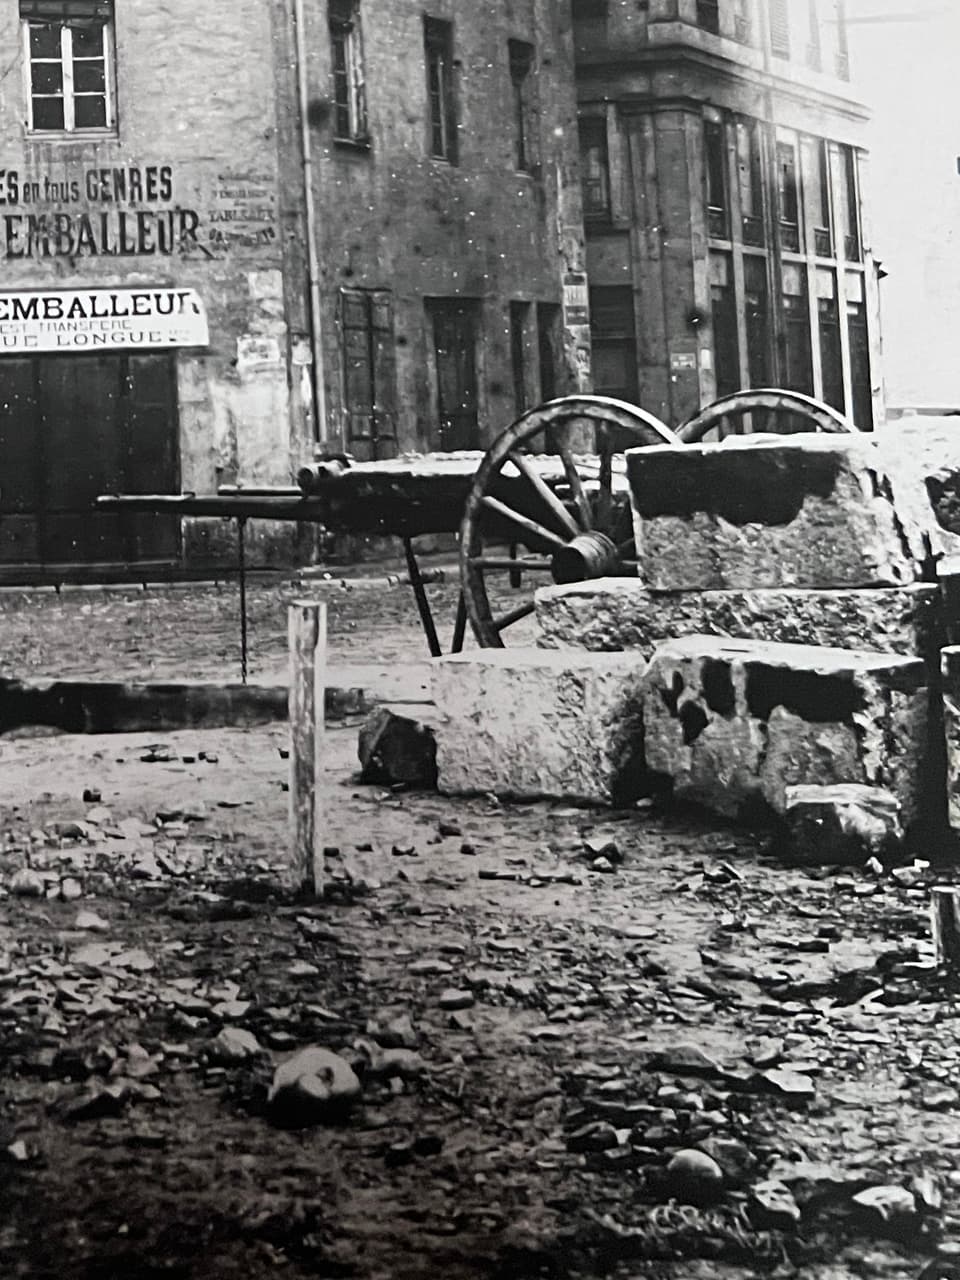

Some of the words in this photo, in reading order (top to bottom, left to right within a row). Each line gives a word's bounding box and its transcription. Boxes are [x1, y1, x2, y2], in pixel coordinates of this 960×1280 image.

[23, 181, 40, 204] en
[44, 176, 80, 204] tous
[86, 166, 172, 203] GENRES
[3, 208, 215, 260] EMBALLEUR
[56, 331, 162, 347] LONGUE
